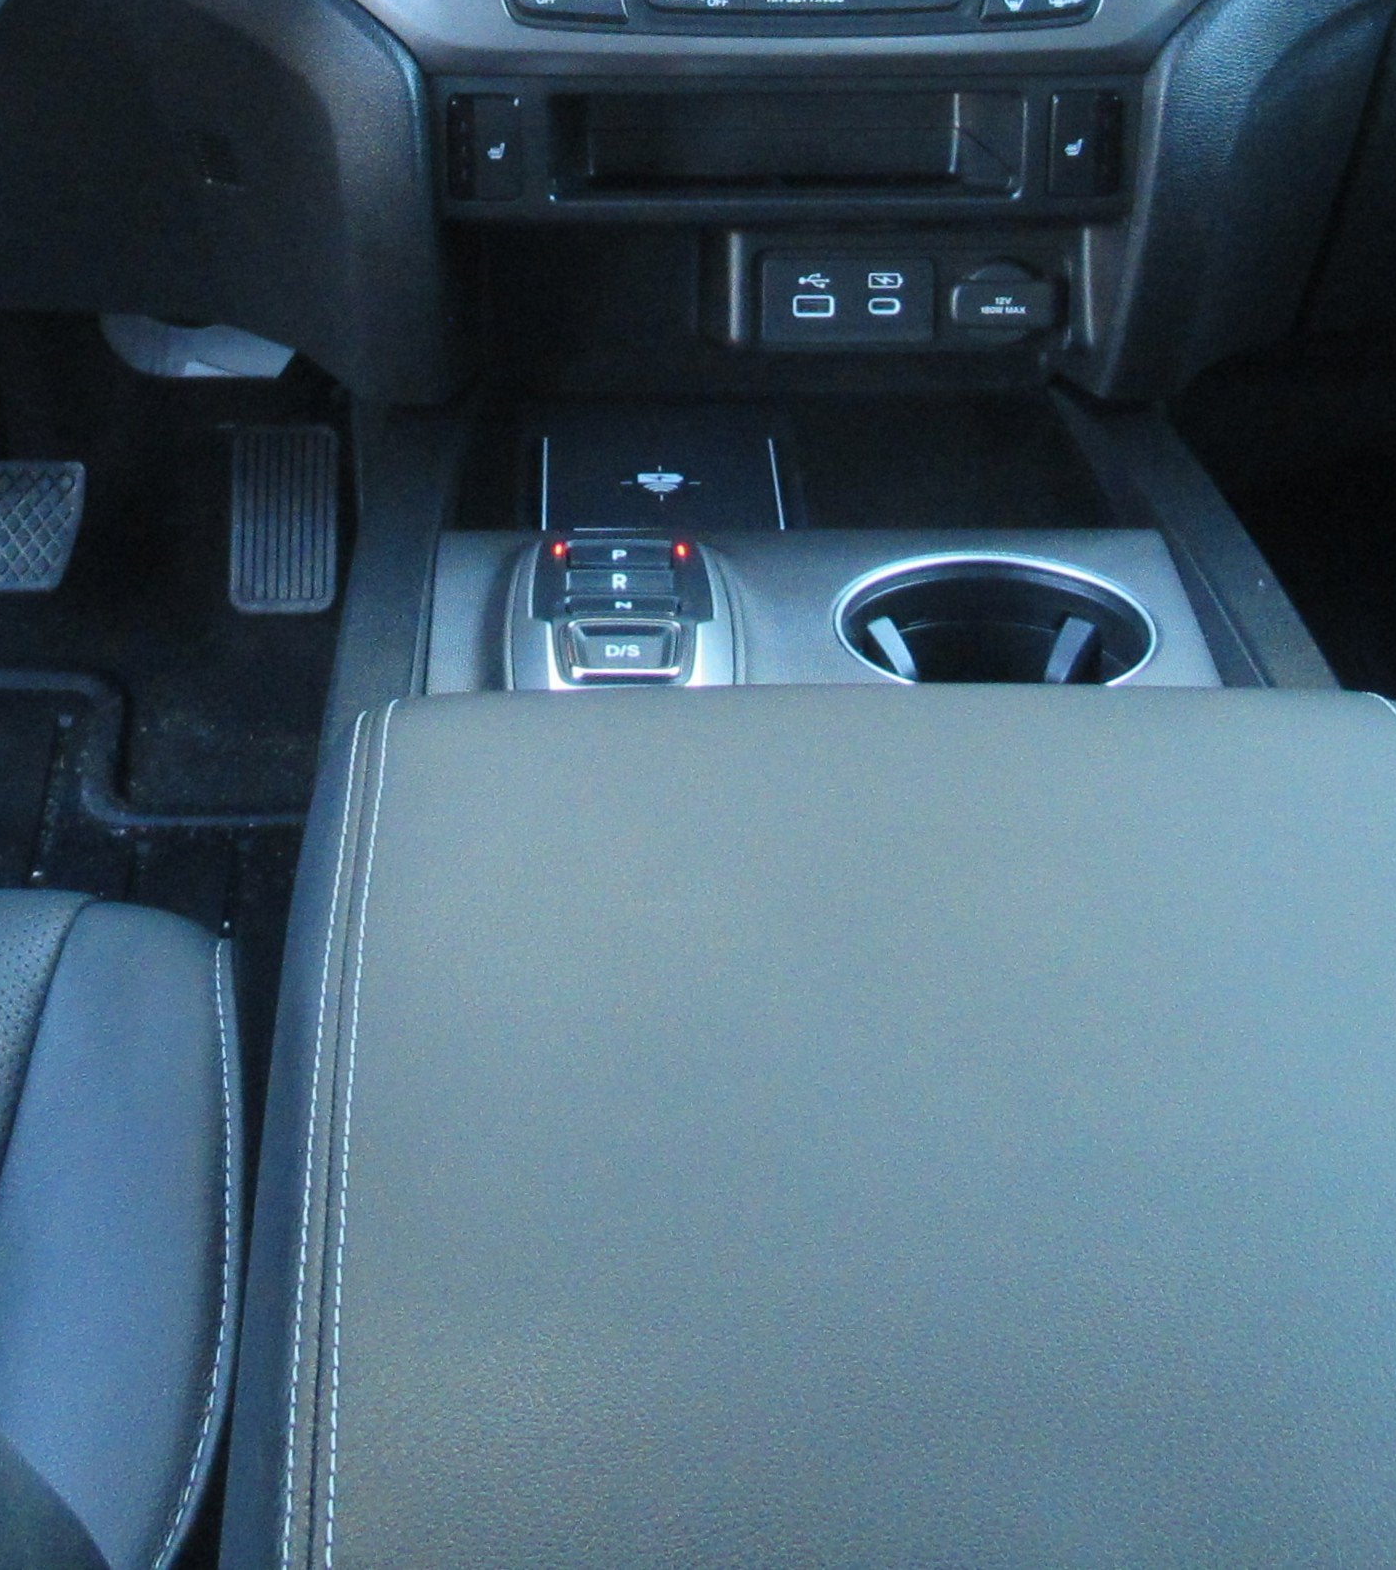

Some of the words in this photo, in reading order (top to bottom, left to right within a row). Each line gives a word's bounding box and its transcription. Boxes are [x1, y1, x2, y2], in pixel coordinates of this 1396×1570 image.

[994, 296, 1013, 305] 12V
[611, 549, 627, 560] P
[611, 573, 627, 590] R
[614, 601, 633, 609] N
[605, 644, 641, 658] D/S
